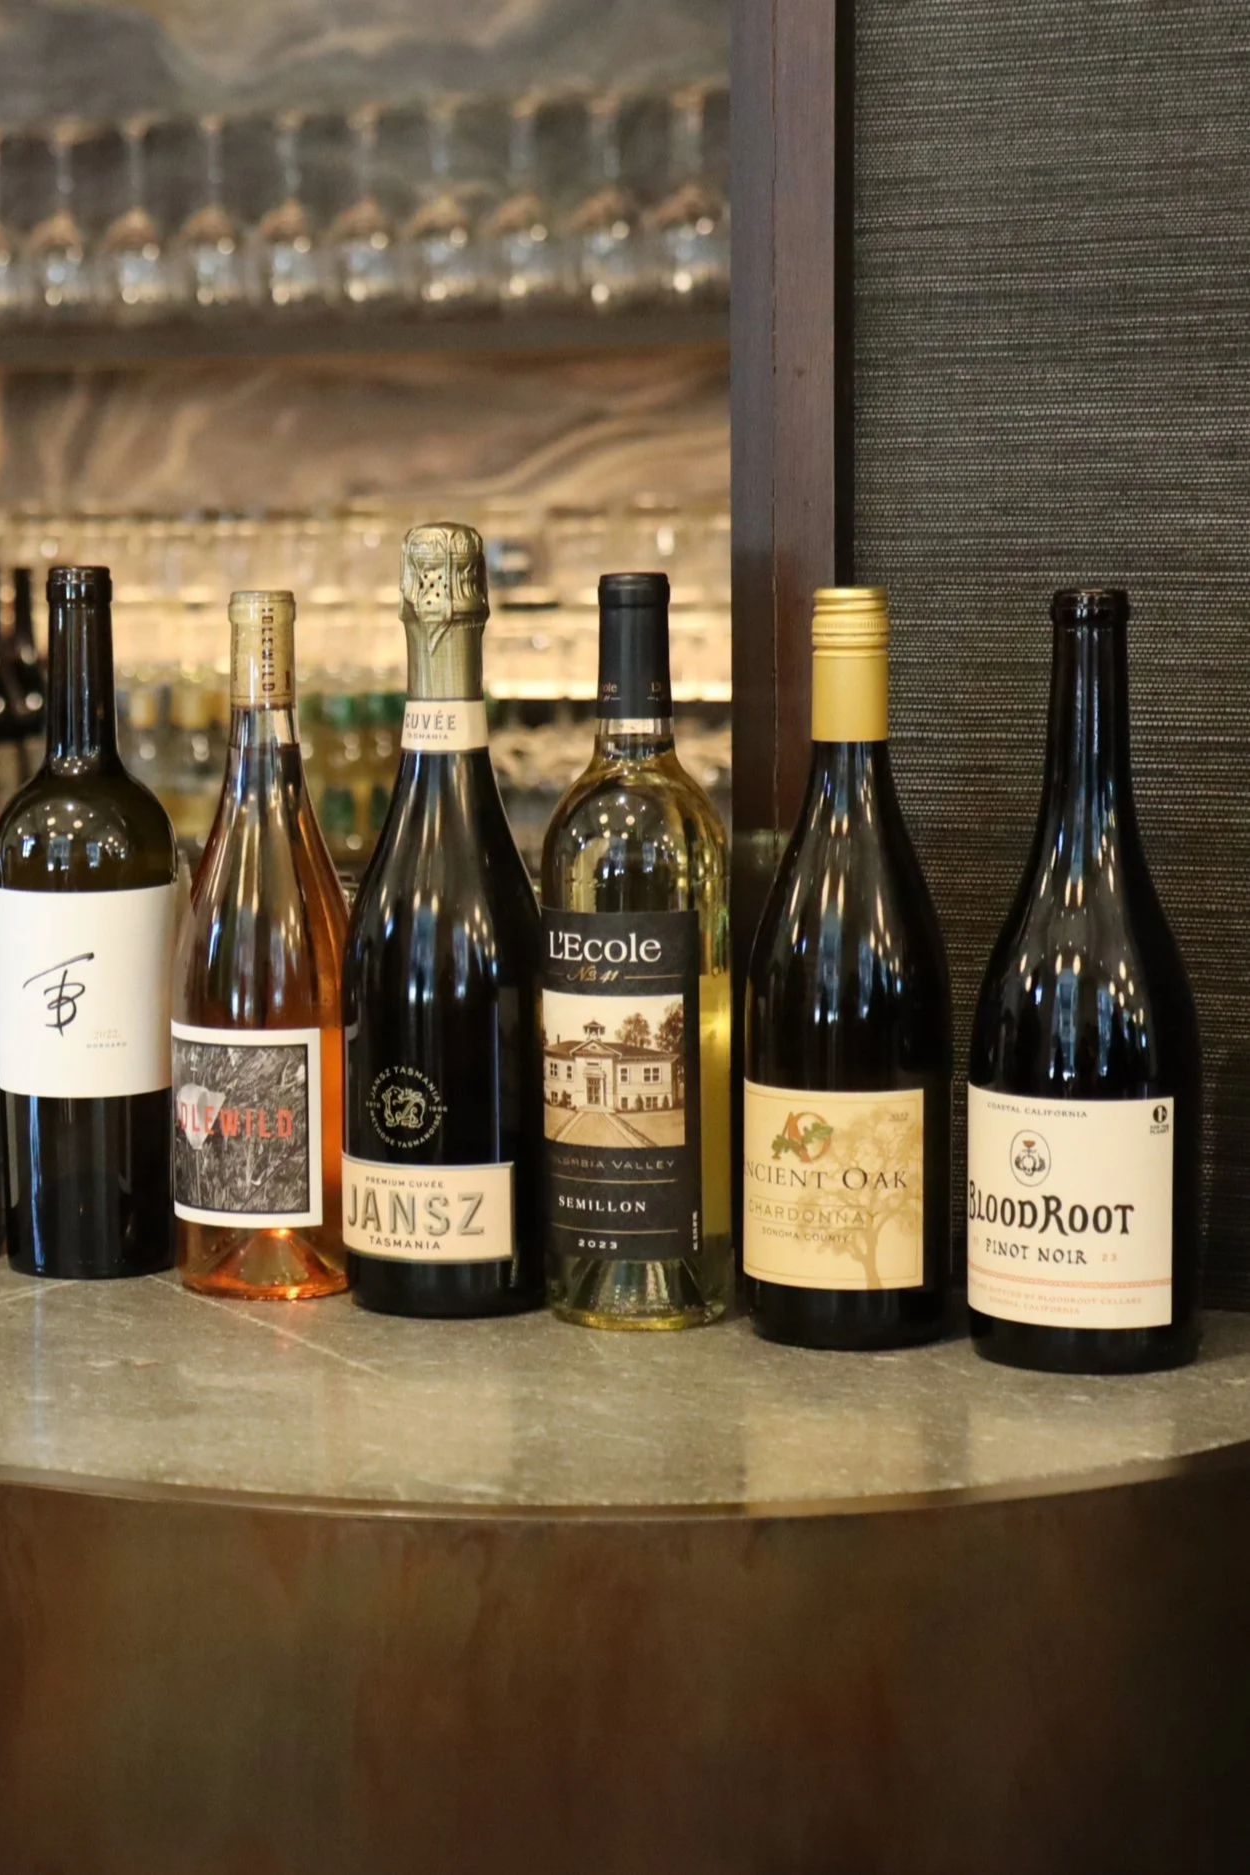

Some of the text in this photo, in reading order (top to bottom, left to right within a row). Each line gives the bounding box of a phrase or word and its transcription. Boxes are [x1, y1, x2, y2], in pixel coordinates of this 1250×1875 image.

[405, 709, 456, 731] CUVÉE
[548, 929, 662, 963] L'Ecole
[599, 970, 620, 983] 41
[369, 1065, 441, 1103] JANSZ TASMANIA
[177, 1101, 293, 1138] DLEWILD
[986, 1101, 1088, 1119] COASTAL CALIFORNIA
[554, 1155, 675, 1171] LUMBIA VALLEY
[365, 1175, 445, 1188] PREMIUM CUVÉE
[745, 1160, 829, 1190] NCIENT
[348, 1183, 485, 1237] JANSZ
[557, 1194, 647, 1214] SEMILLON
[749, 1198, 879, 1225] CHARDONNAY
[368, 1234, 442, 1250] TASMANIA
[577, 1238, 618, 1250] 2023
[761, 1227, 849, 1244] SONOMA COUNTY
[985, 1238, 1030, 1261] PINOT
[1037, 1247, 1088, 1265] NOIR
[1023, 1303, 1082, 1315] CALIFORNIA
